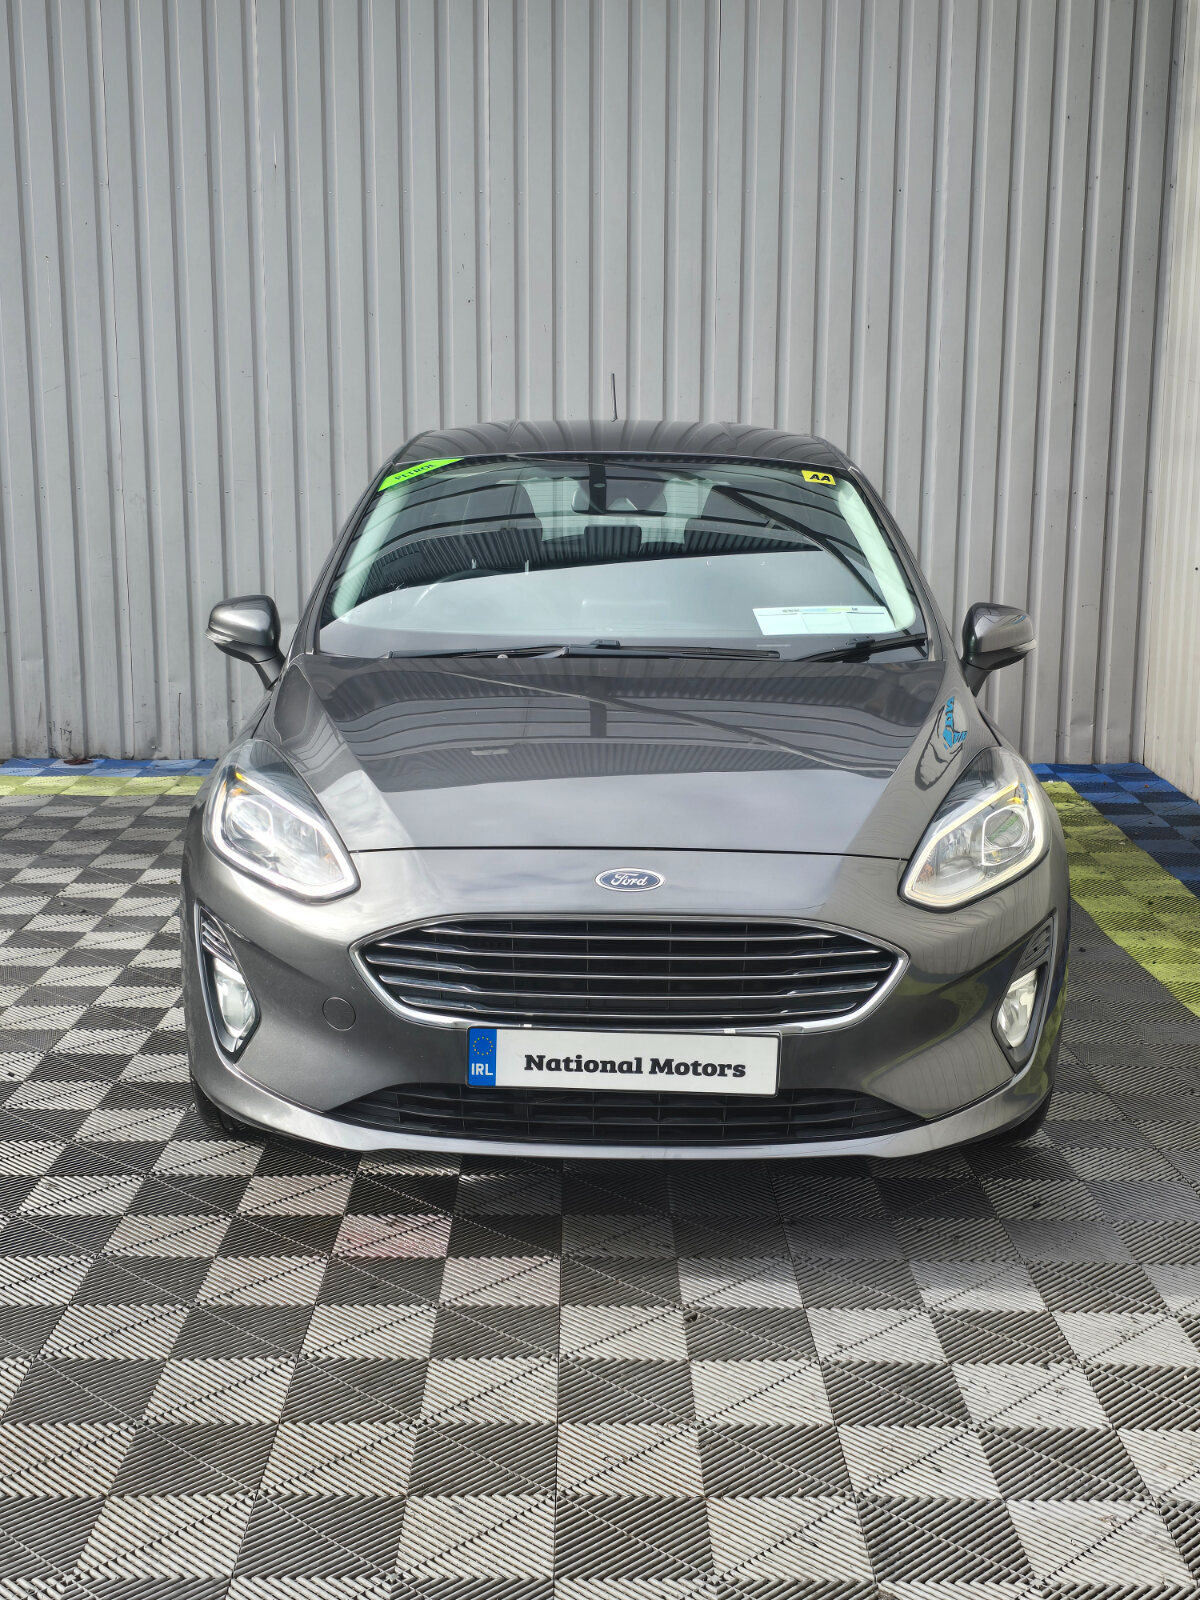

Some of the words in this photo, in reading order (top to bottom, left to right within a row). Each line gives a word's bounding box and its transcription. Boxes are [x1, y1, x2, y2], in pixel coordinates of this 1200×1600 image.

[809, 473, 831, 482] AA
[610, 871, 649, 886] Ford
[471, 1062, 494, 1076] IRL
[524, 1054, 643, 1074] National
[648, 1058, 746, 1078] Motors
